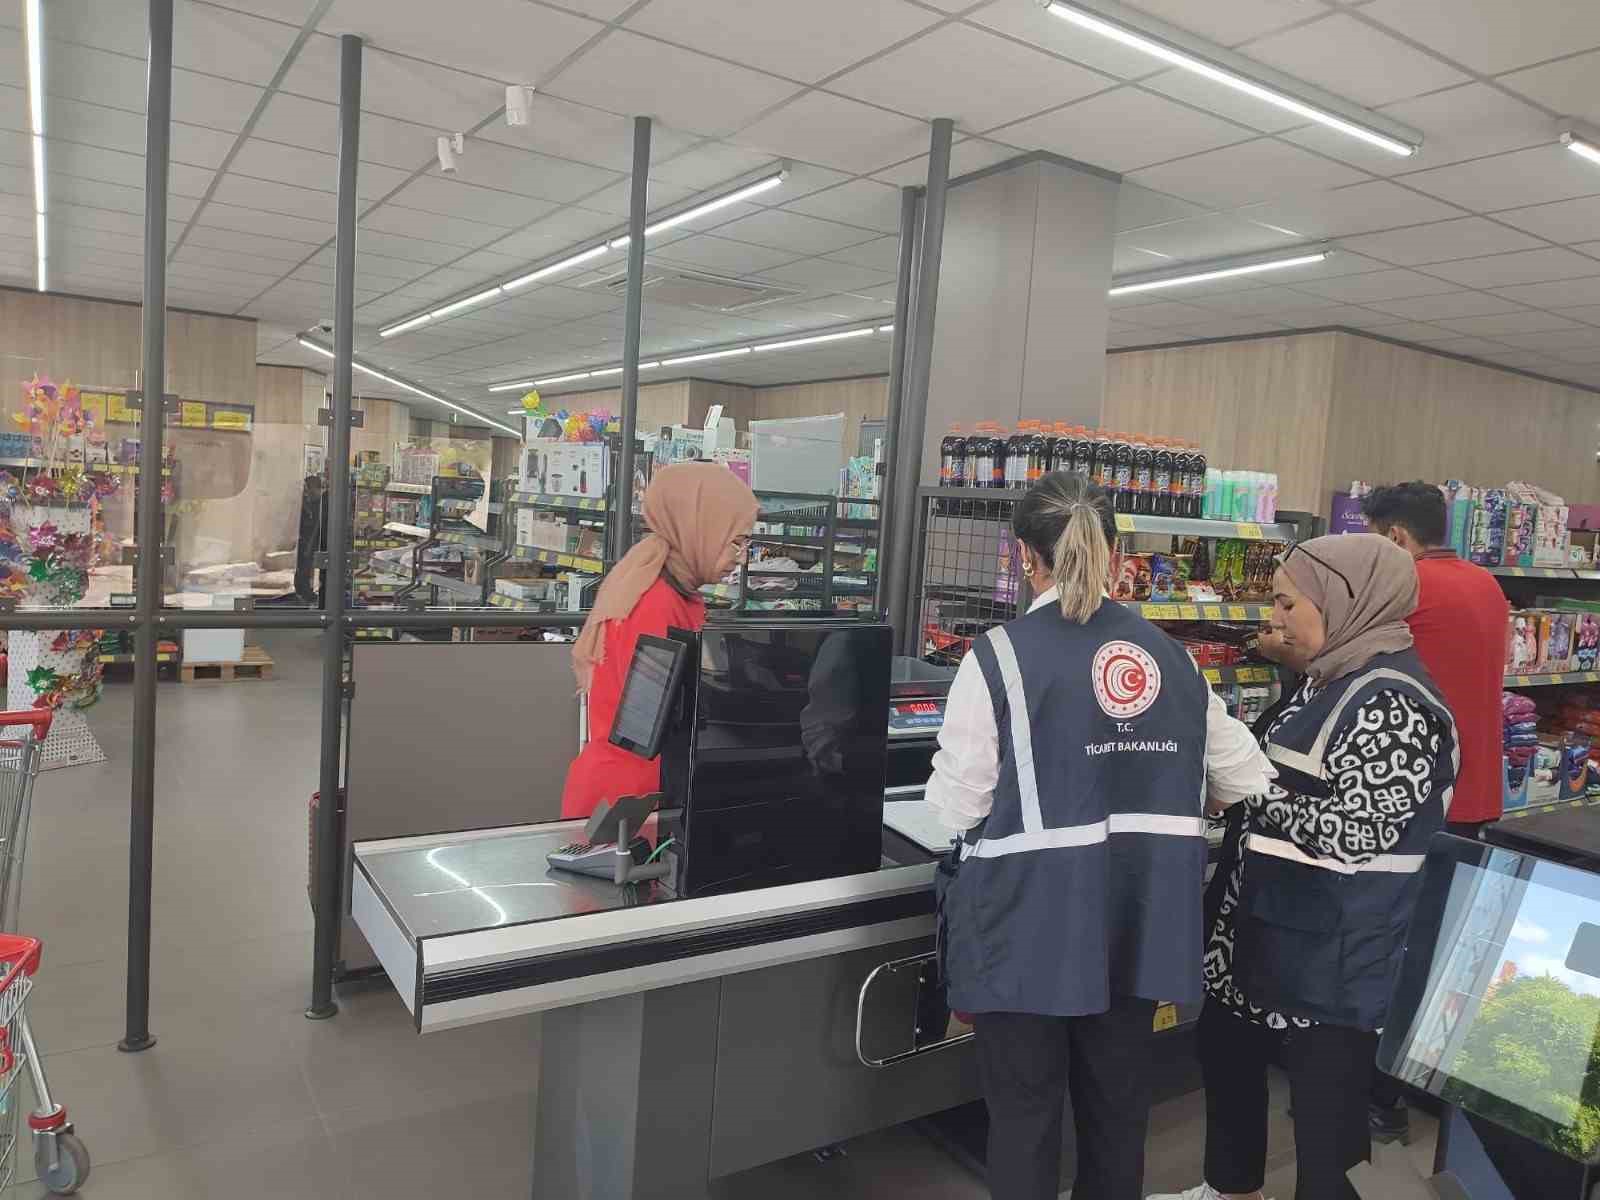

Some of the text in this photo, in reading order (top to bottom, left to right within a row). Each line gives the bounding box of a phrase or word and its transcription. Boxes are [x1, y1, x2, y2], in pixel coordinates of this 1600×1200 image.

[1116, 722, 1134, 732] T.C.
[1085, 740, 1178, 756] TİCARET BAKANLIĞI
